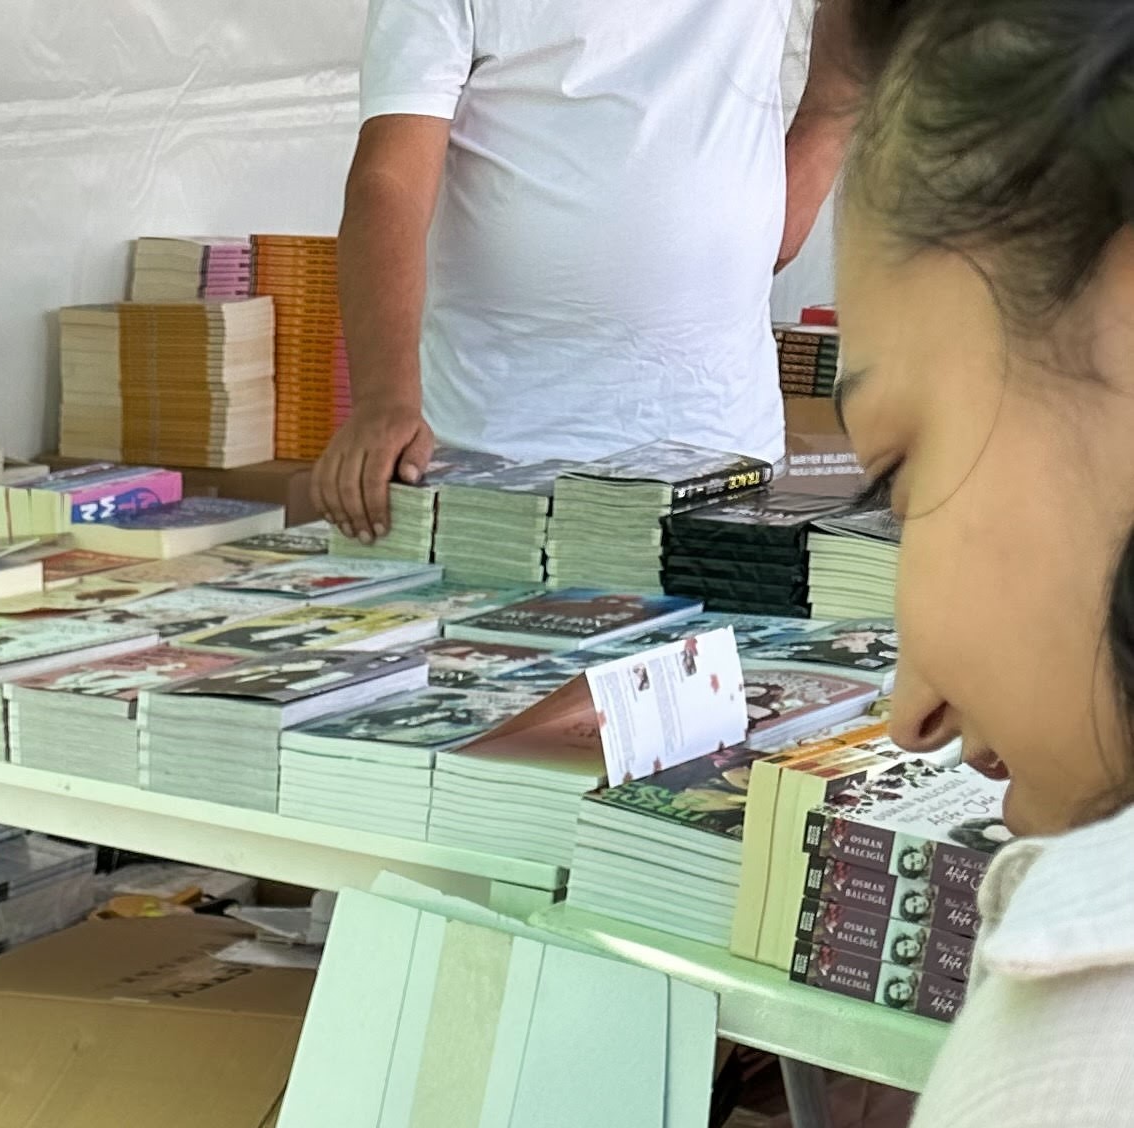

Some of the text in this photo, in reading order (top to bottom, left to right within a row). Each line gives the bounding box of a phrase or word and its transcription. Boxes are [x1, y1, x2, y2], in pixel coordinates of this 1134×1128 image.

[849, 835, 884, 849] OSMAN
[851, 878, 886, 893] OSMAN
[843, 921, 878, 937] OSMAN
[836, 964, 870, 980] OSMAN
